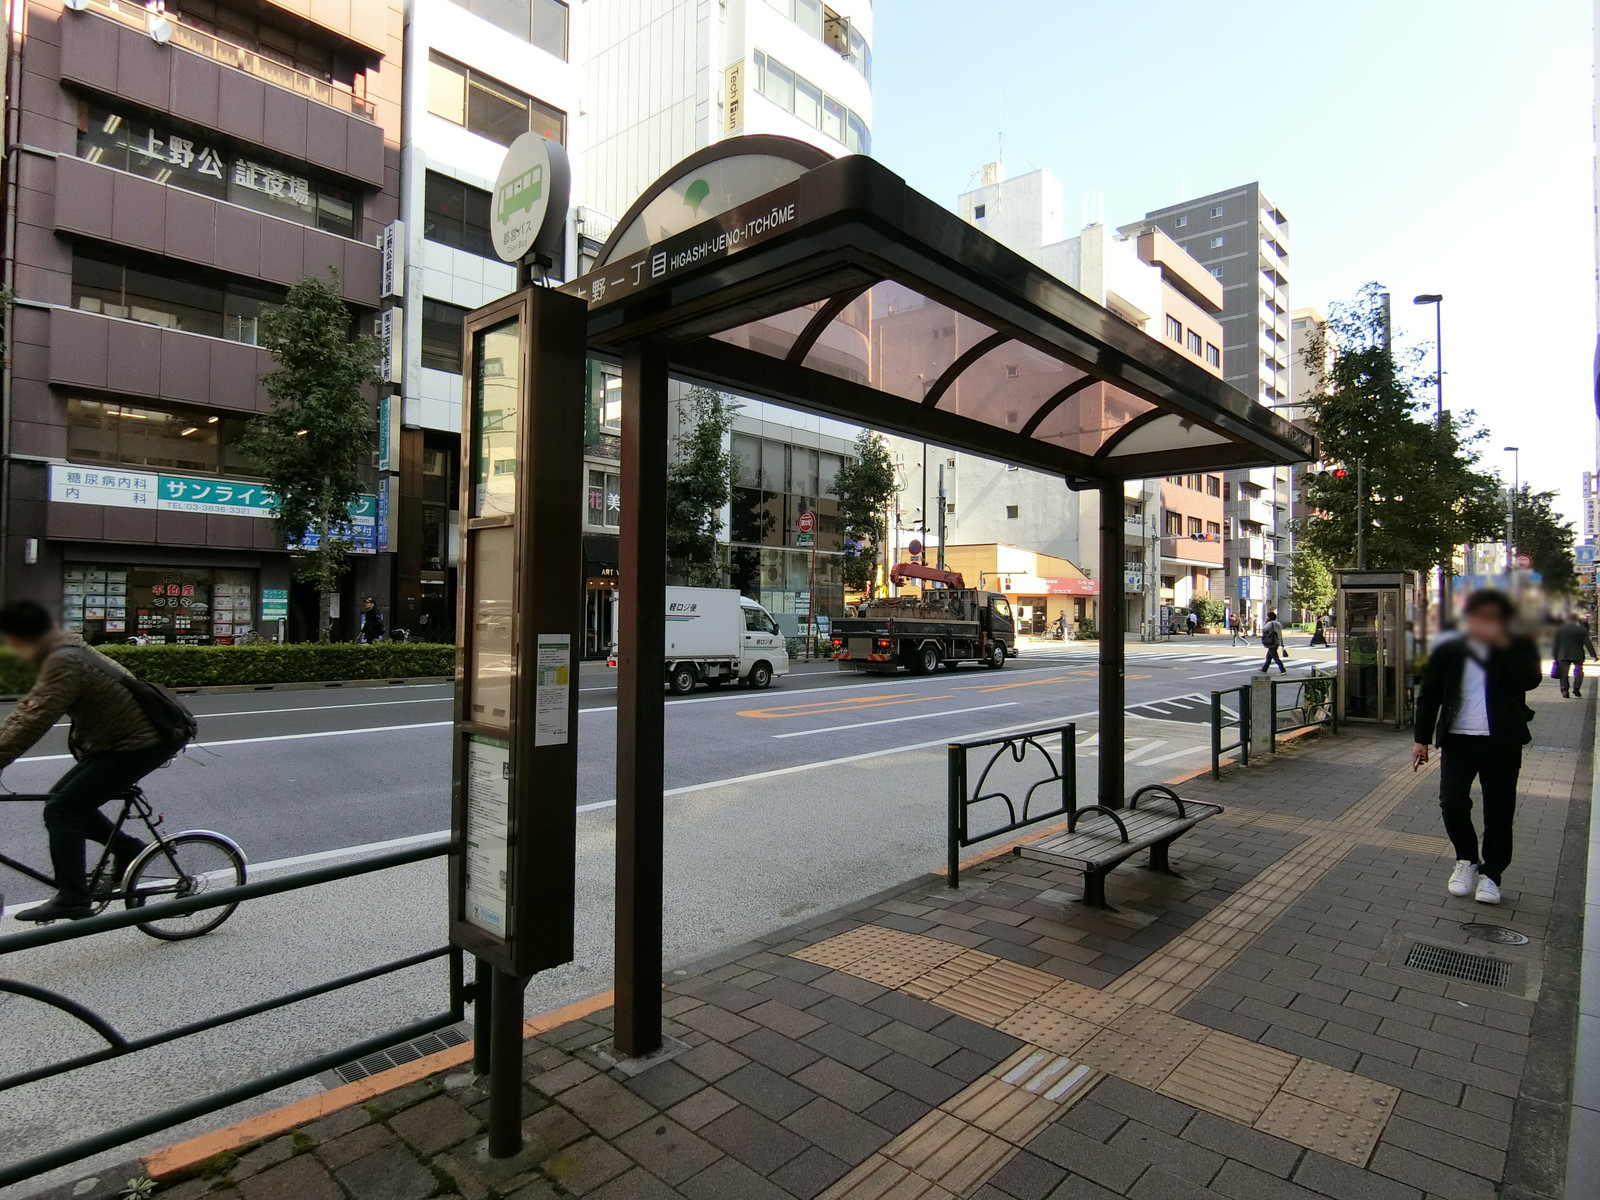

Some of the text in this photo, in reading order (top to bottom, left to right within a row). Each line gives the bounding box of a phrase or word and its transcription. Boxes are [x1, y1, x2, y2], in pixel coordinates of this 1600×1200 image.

[503, 220, 532, 246] 都営バス
[67, 471, 148, 490] 糖尿病内科
[601, 568, 614, 576] ART
[152, 584, 195, 597] 不動産
[153, 597, 192, 608] つるや
